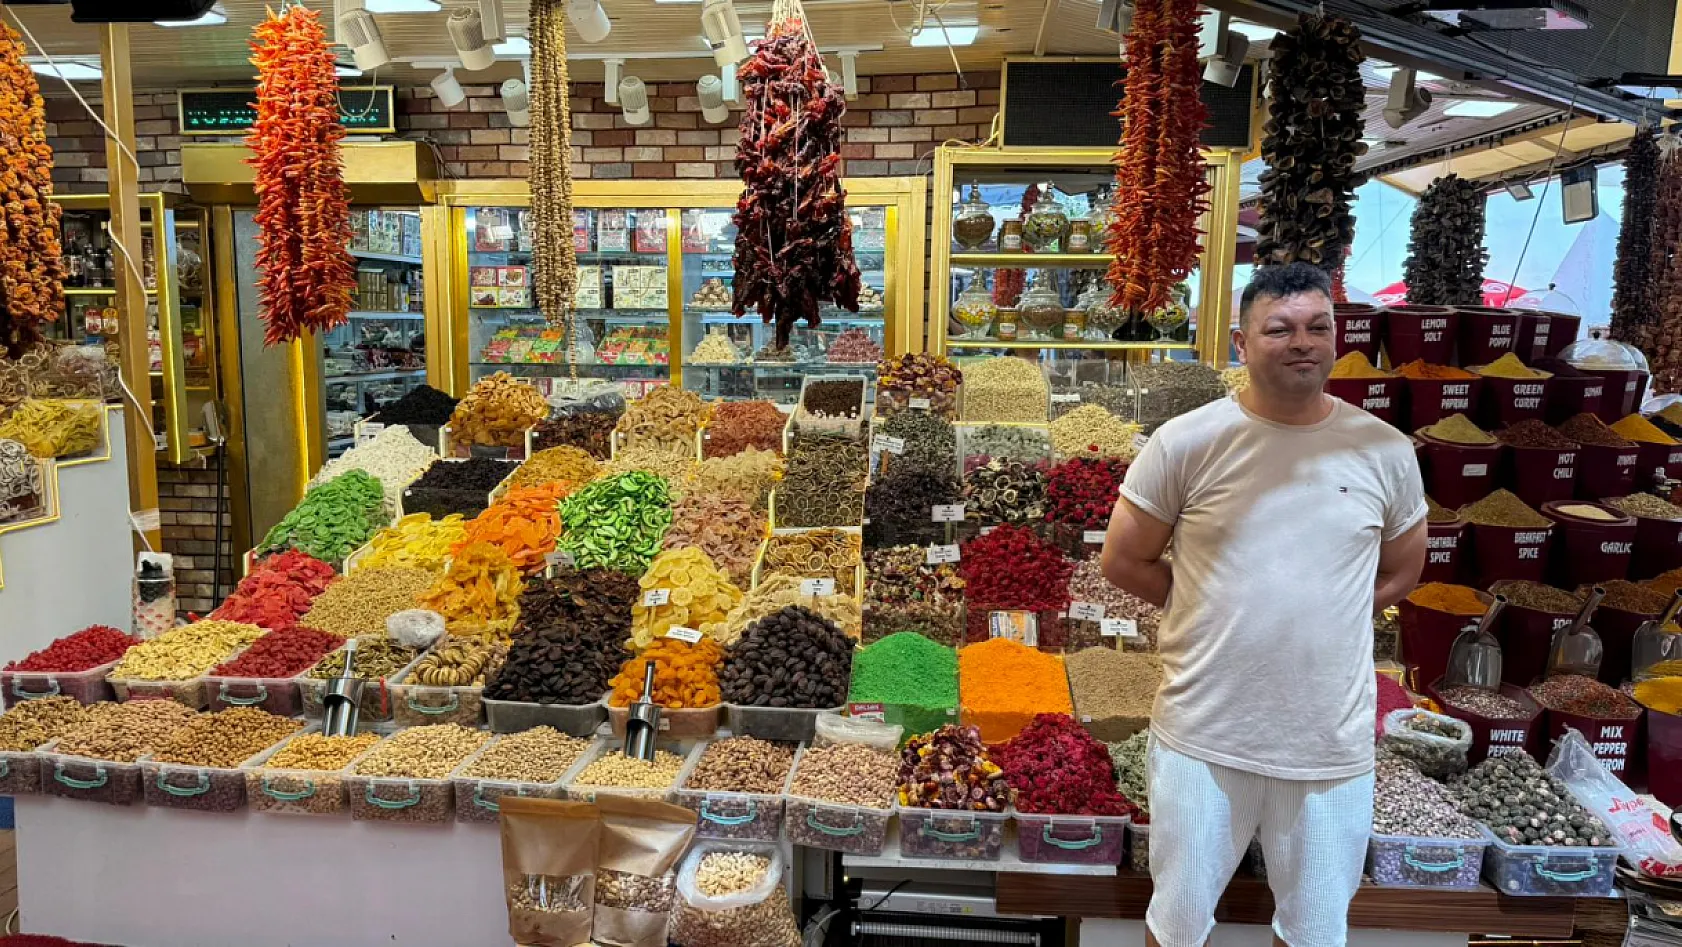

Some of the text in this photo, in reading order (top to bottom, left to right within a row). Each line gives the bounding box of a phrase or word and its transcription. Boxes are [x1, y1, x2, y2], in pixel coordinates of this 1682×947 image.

[1345, 319, 1371, 330] BLACK
[1421, 318, 1447, 330] LEMON
[1488, 337, 1511, 348] POPPY
[1368, 384, 1386, 396] HOT
[1442, 384, 1470, 395] SWEET
[1513, 384, 1544, 395] GREEN
[1558, 453, 1575, 465] HOT
[1553, 467, 1573, 479] CHILI
[1518, 547, 1539, 559] SPICE
[1600, 541, 1633, 553] GARLIC
[1429, 551, 1450, 563] SPICE
[1489, 729, 1525, 742] WHITE
[1600, 726, 1624, 738] MIX
[1593, 742, 1628, 755] PEPPER
